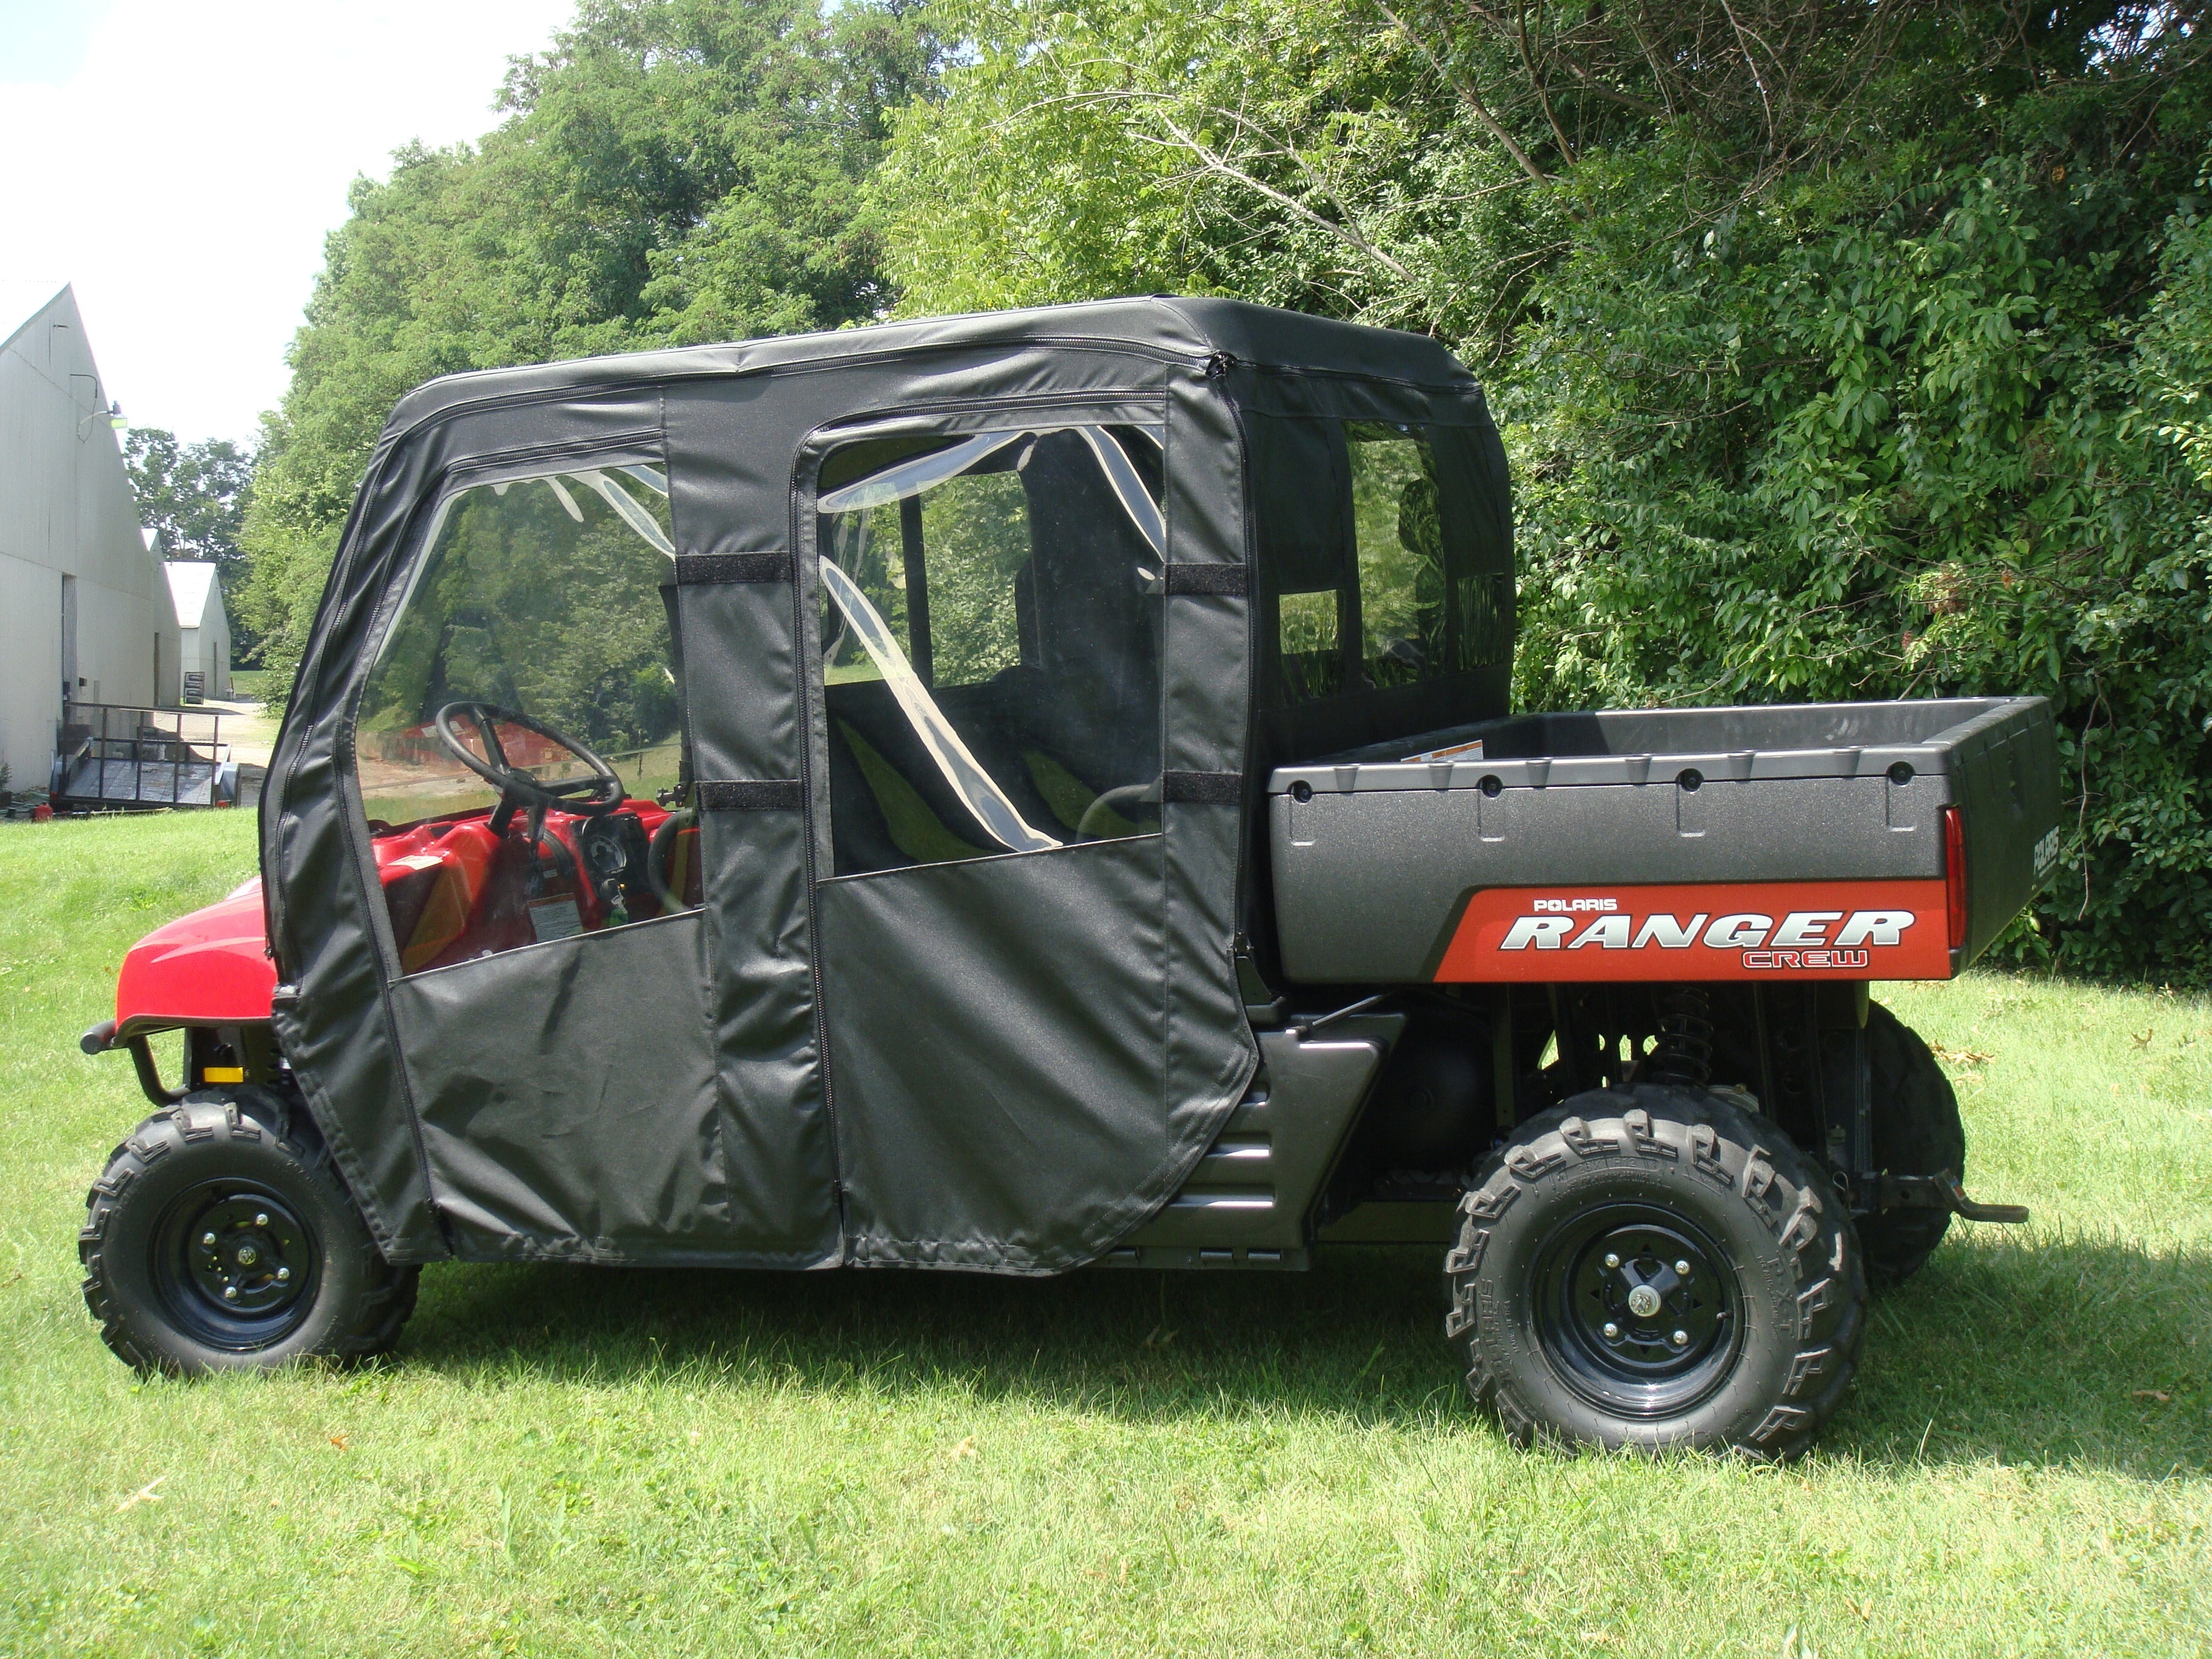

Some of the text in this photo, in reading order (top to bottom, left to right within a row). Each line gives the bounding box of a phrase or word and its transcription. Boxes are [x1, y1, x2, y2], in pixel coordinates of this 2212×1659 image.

[1533, 899, 1618, 912] POLARIS
[1499, 910, 1916, 949] RANGER
[1742, 950, 1869, 968] CREW
